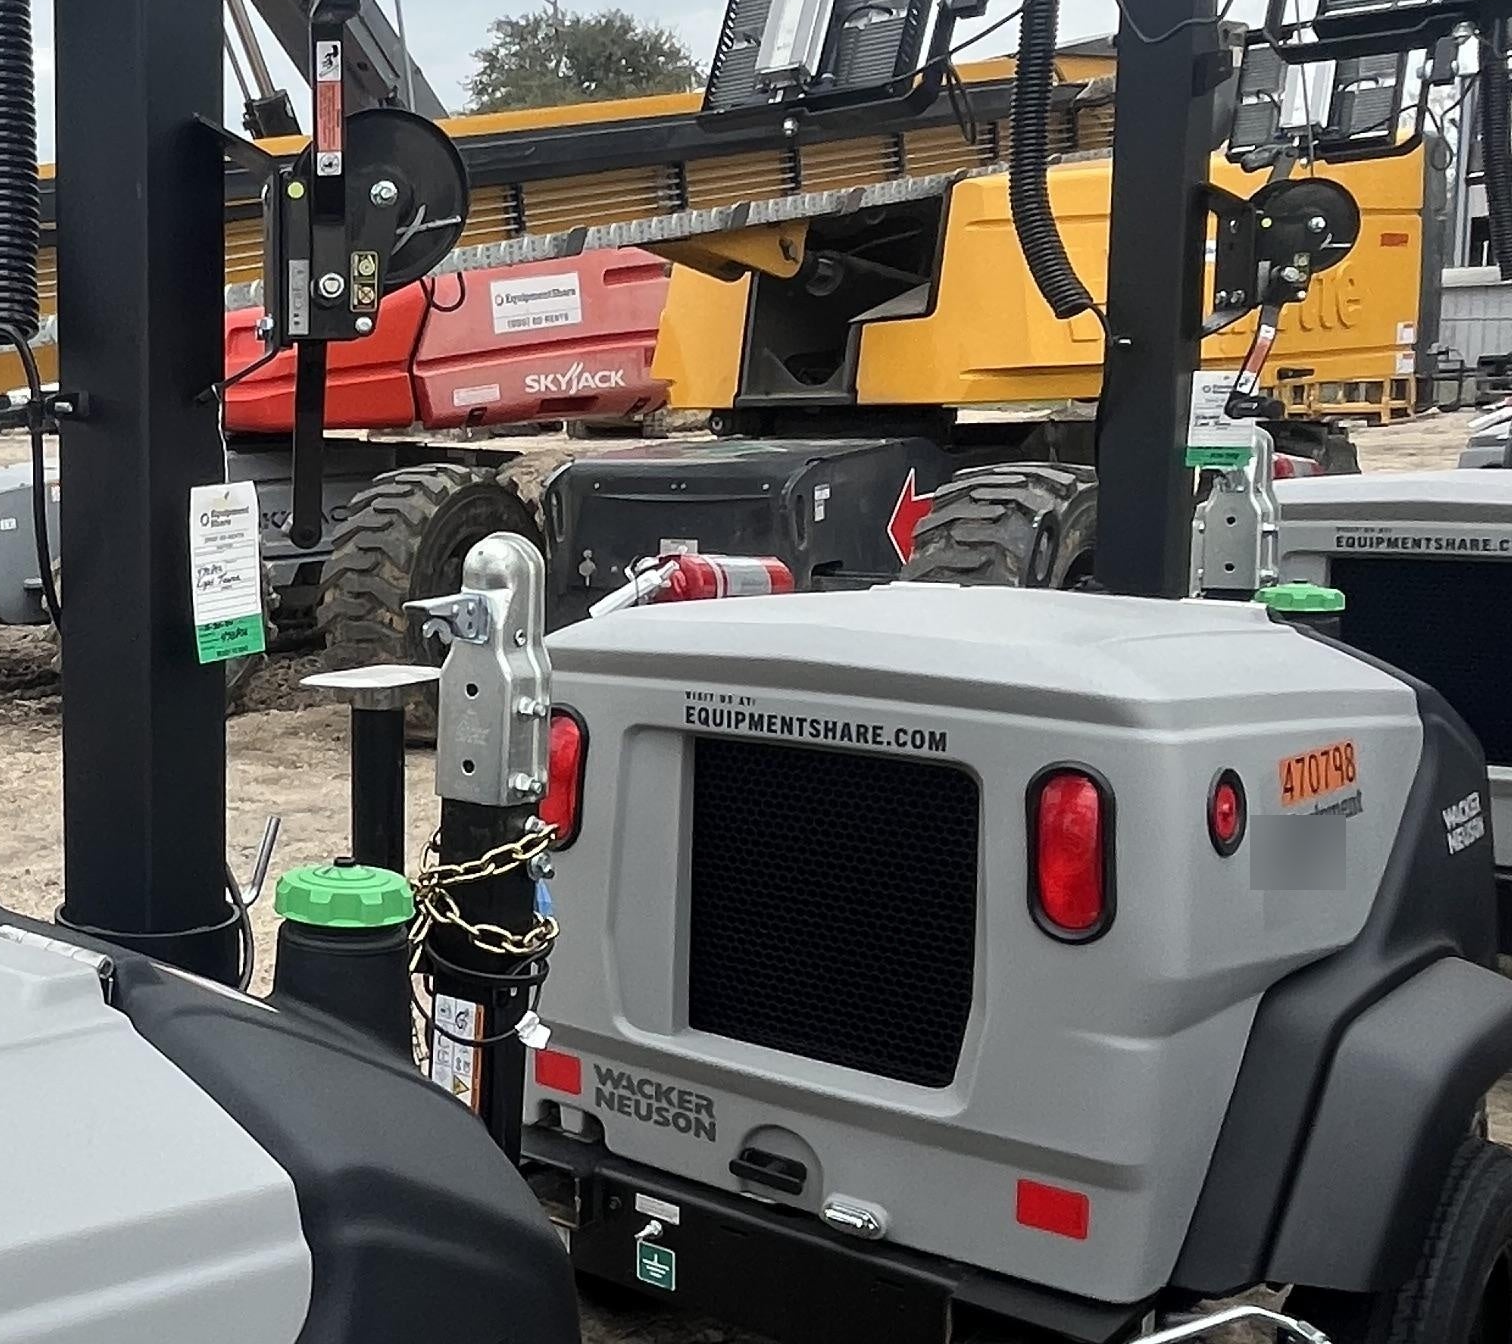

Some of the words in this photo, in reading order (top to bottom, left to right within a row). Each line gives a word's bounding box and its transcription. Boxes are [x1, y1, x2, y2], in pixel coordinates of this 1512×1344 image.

[525, 362, 626, 395] SKYJACK
[685, 706, 948, 753] EQUIPMENTSHARE.COM
[1283, 742, 1357, 801] 470798
[593, 1063, 717, 1119] WACKER
[594, 1086, 717, 1143] NEUSON
